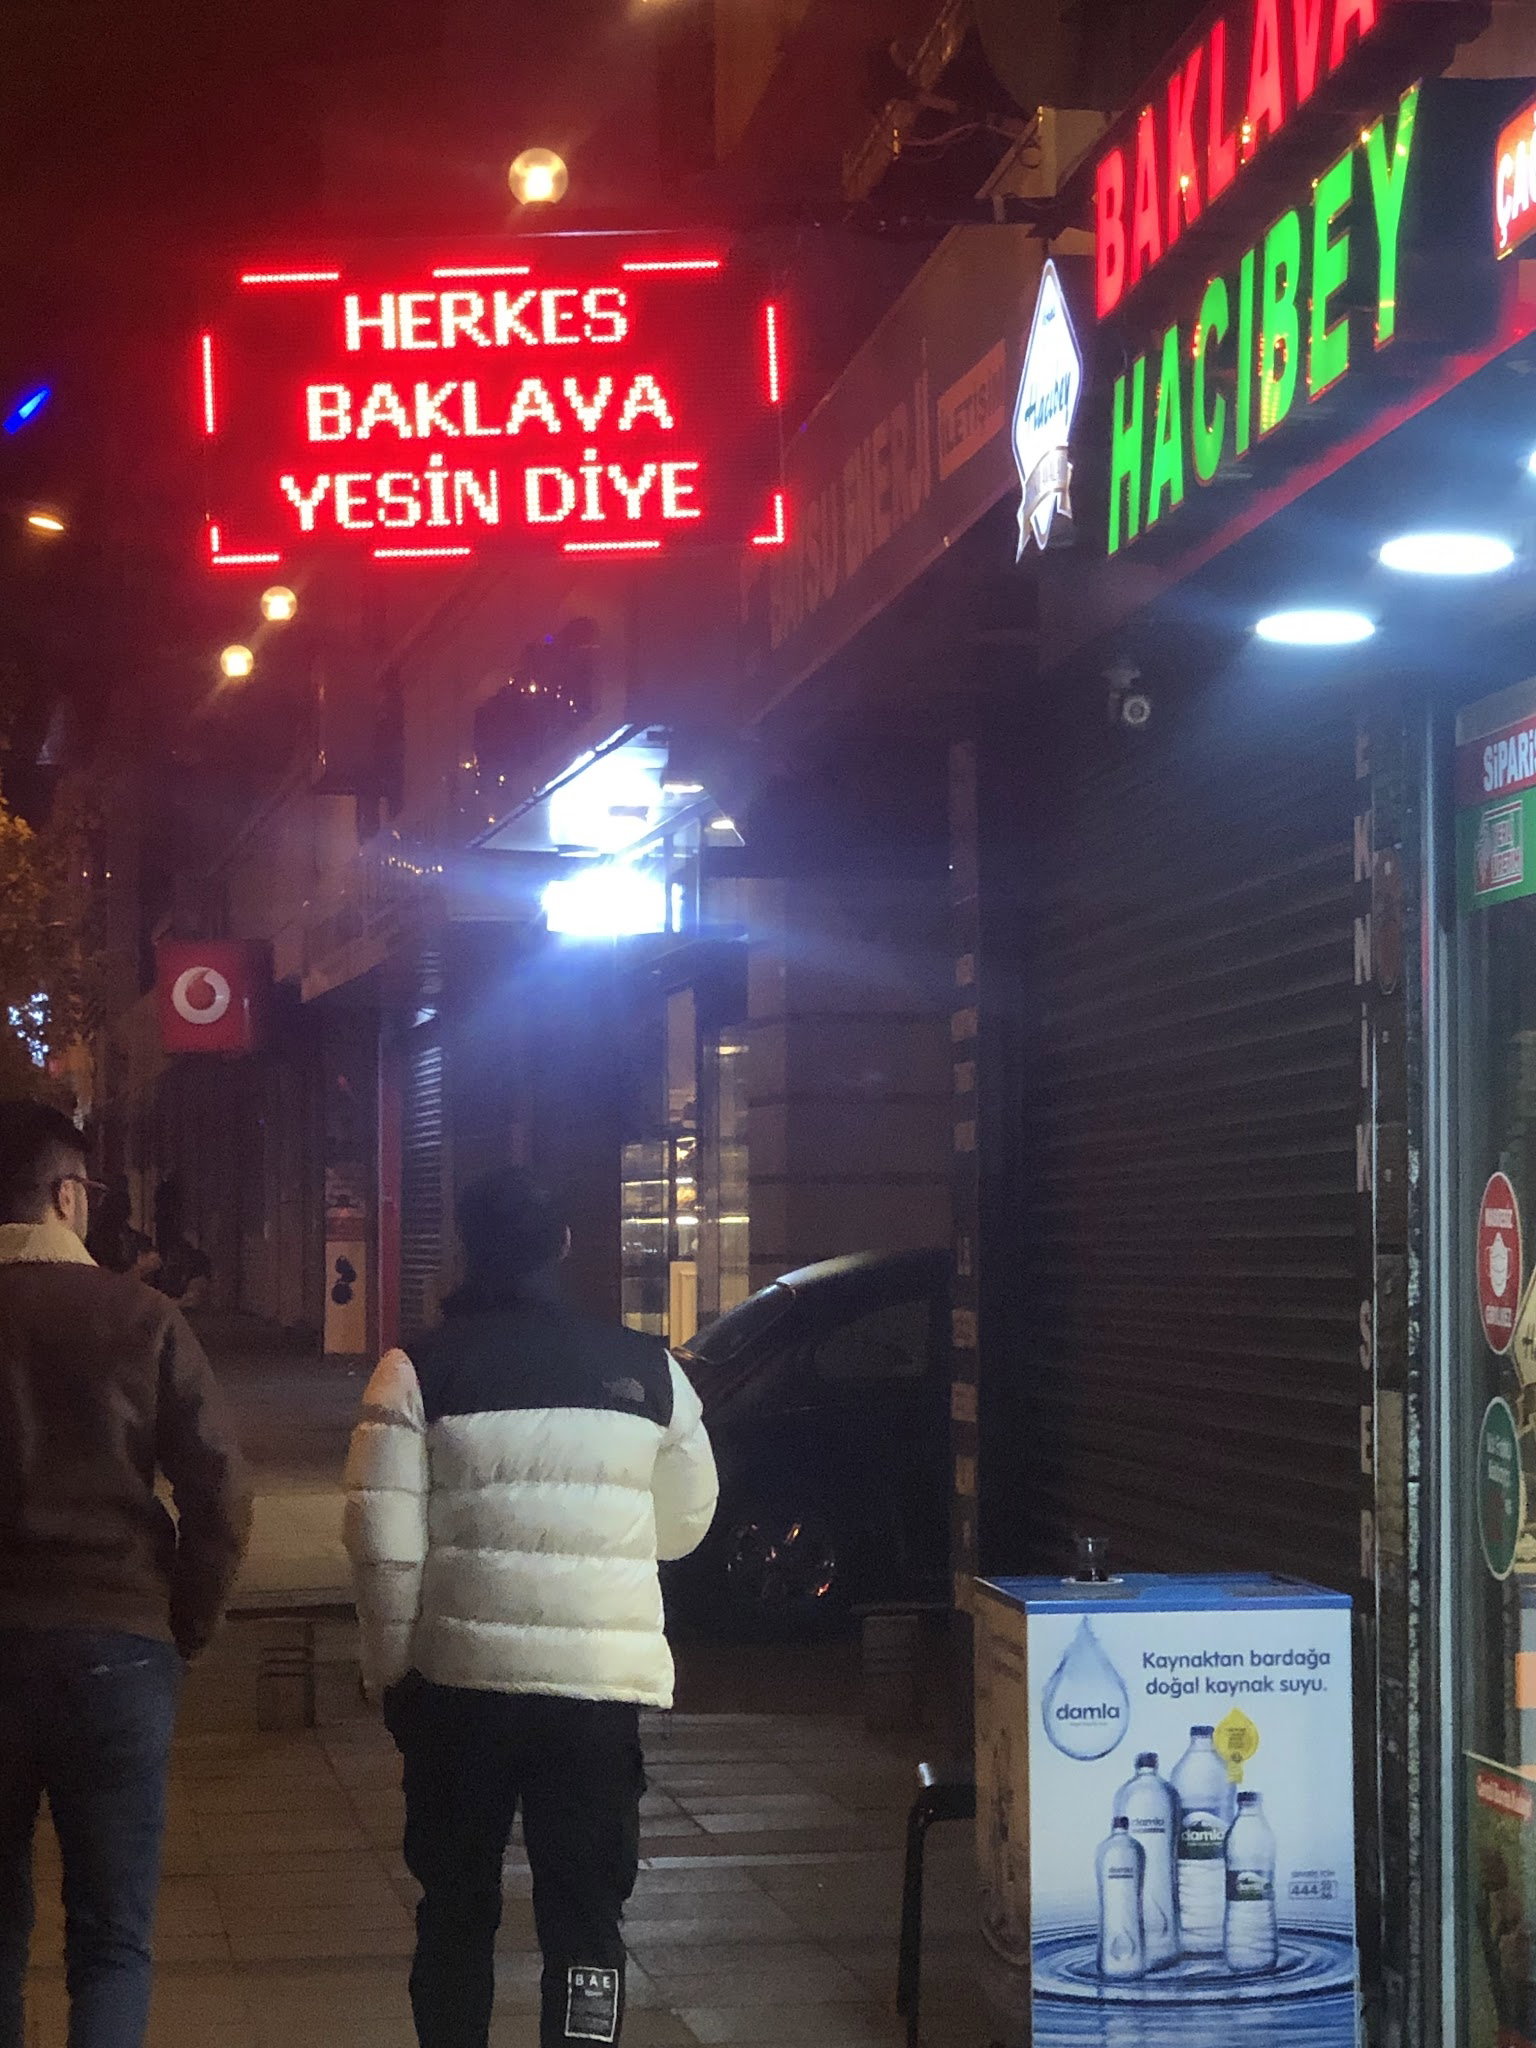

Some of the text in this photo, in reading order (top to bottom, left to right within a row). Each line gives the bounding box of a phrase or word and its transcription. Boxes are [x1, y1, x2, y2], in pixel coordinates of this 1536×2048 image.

[344, 287, 628, 351] HERKES
[1107, 83, 1419, 557] HACIBEY
[306, 374, 675, 442] BAKLAVA
[279, 447, 700, 531] YESİN DİYE
[1143, 1648, 1331, 1672] Kaynaktan bardağa
[1146, 1676, 1328, 1698] doğal kaynak suyu.
[1056, 1702, 1120, 1720] damla
[575, 1974, 611, 1989] BAE
